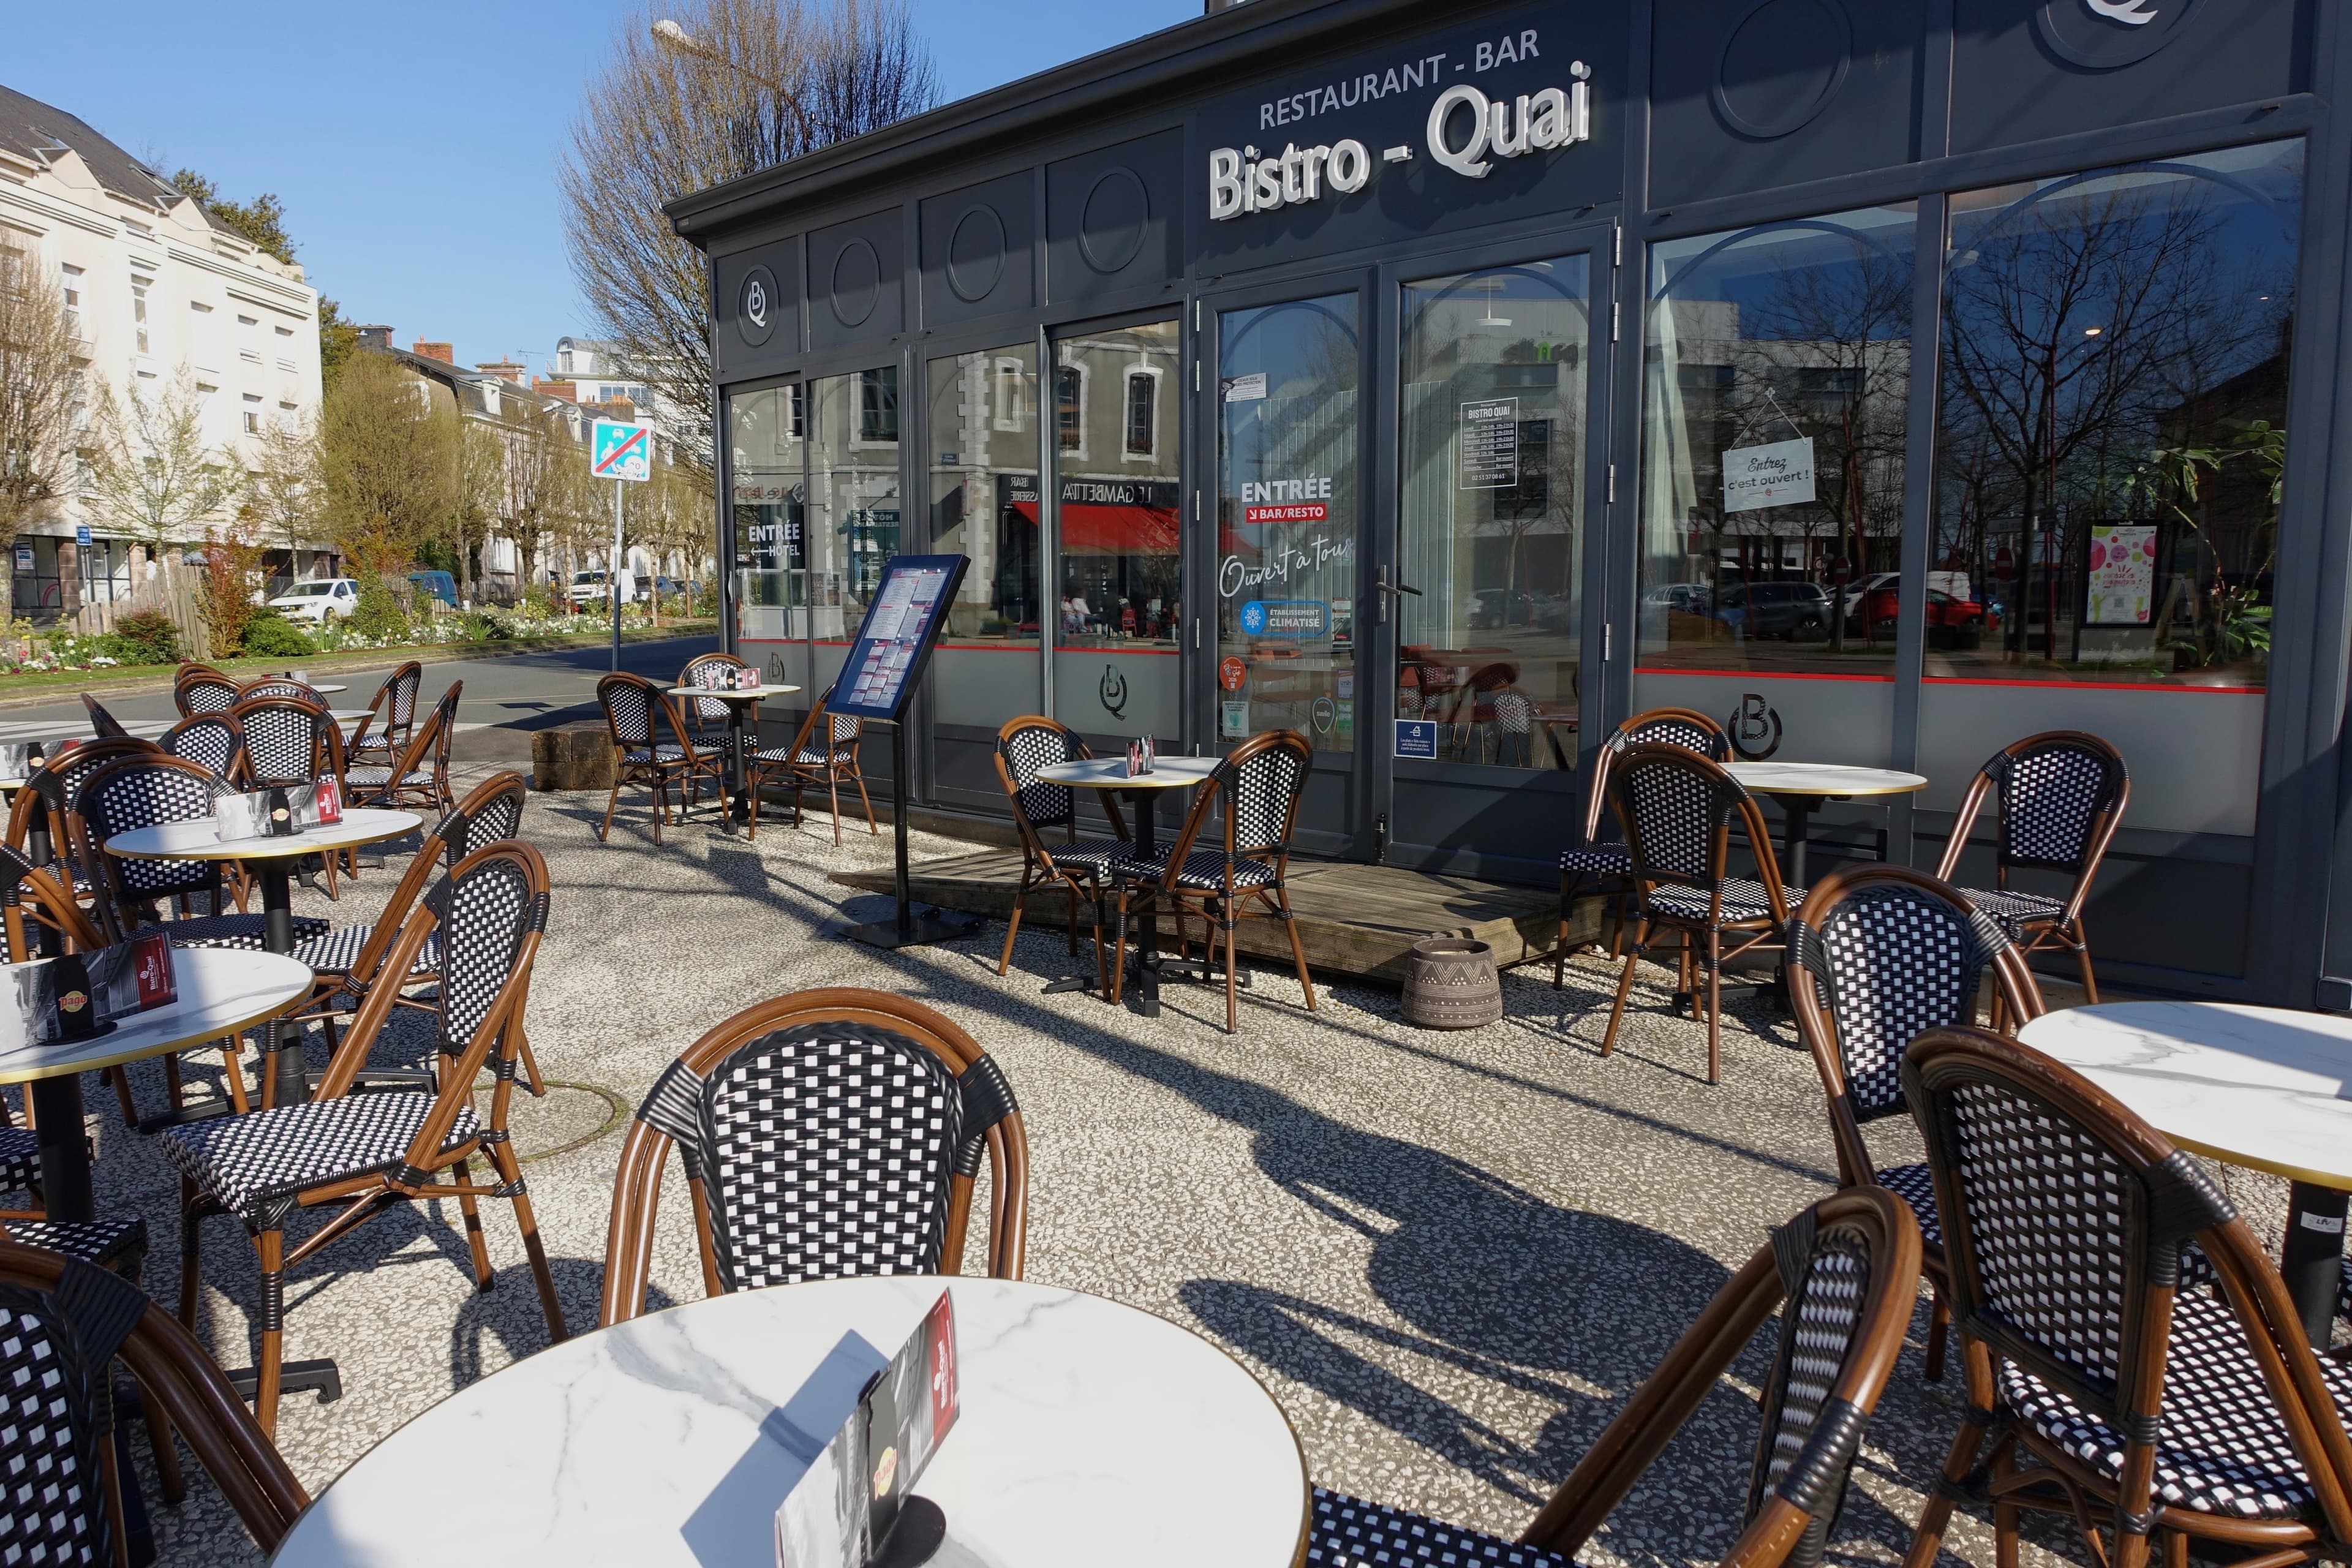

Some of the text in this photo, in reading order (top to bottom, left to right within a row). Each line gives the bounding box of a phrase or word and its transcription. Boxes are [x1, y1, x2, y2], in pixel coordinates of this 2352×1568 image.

[1260, 54, 1446, 130] RESTAURANT
[1476, 29, 1539, 72] BAR
[1210, 138, 1371, 221] Bistro
[1427, 60, 1591, 179] Quai
[1468, 405, 1510, 419] BISTRO QUAI
[1748, 456, 1787, 473] Entrez
[1242, 473, 1332, 502] ENTRÉE
[1728, 478, 1756, 489] c'est
[1760, 472, 1801, 485] ouvert
[1259, 507, 1324, 519] BAR/RESTO
[749, 519, 800, 541] ENTRÉE
[769, 543, 800, 557] HÔTEL
[1219, 534, 1354, 597] Ouvert à tous
[1270, 616, 1320, 627] CLIMATISÉ
